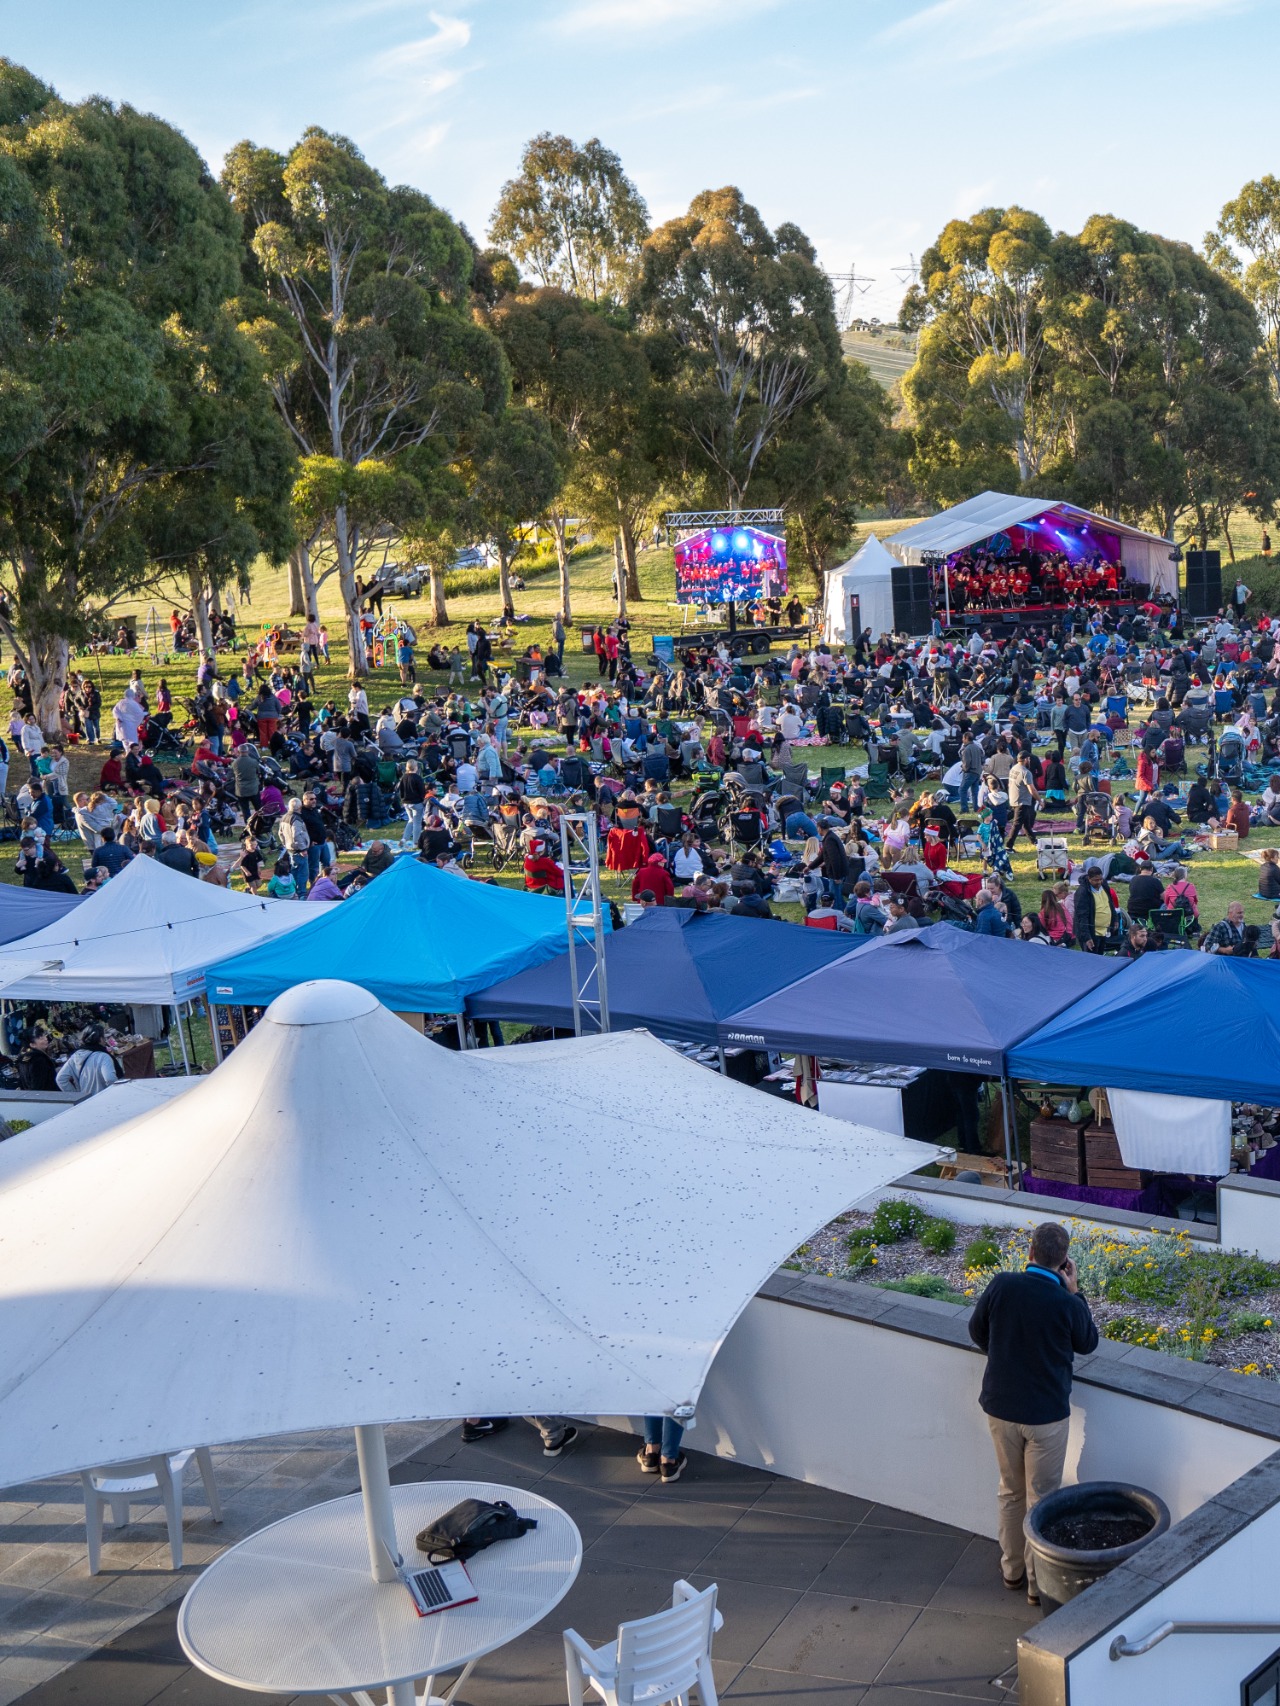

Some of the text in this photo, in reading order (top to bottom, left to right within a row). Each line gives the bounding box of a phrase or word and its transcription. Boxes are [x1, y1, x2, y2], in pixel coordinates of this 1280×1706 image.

[947, 1053, 992, 1067] born to explore
